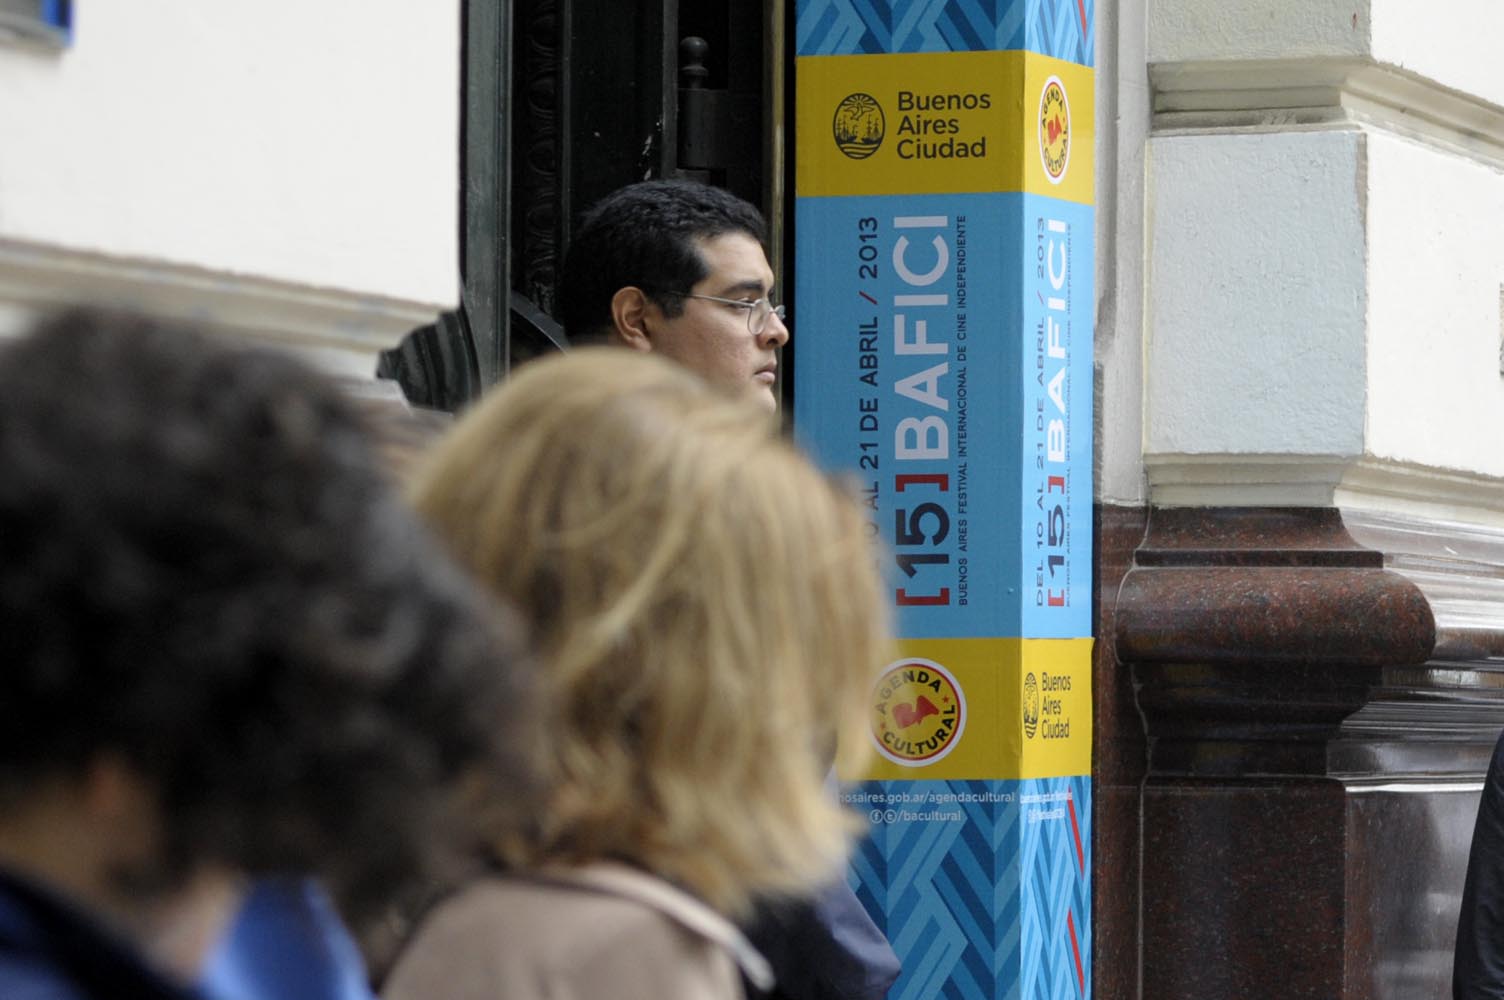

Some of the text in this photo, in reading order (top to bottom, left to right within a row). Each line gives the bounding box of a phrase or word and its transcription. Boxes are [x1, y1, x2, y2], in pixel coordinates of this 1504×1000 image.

[896, 91, 992, 112] Buenos
[896, 114, 960, 136] Aires
[896, 136, 987, 160] Ciudad
[858, 216, 878, 279] 2013
[1037, 217, 1045, 280] 2013
[858, 316, 878, 387] ABRIL
[1037, 317, 1045, 387] ABRIL
[859, 397, 879, 432] DE
[956, 215, 968, 606] BUENOS AIRES FESTIVAL INTERNACIONAL DE CINE INDEPENDIENTE
[1036, 398, 1045, 432] DE
[859, 442, 879, 470] 21
[1036, 442, 1044, 470] 21
[1036, 482, 1044, 511] AL
[1036, 521, 1044, 549] 10
[1036, 559, 1044, 607] DEL
[874, 669, 941, 715] AGENDA
[1041, 671, 1072, 692] Buenos
[1041, 694, 1062, 715] Aires
[882, 704, 956, 755] CULTURAL
[1041, 717, 1071, 740] Ciudad
